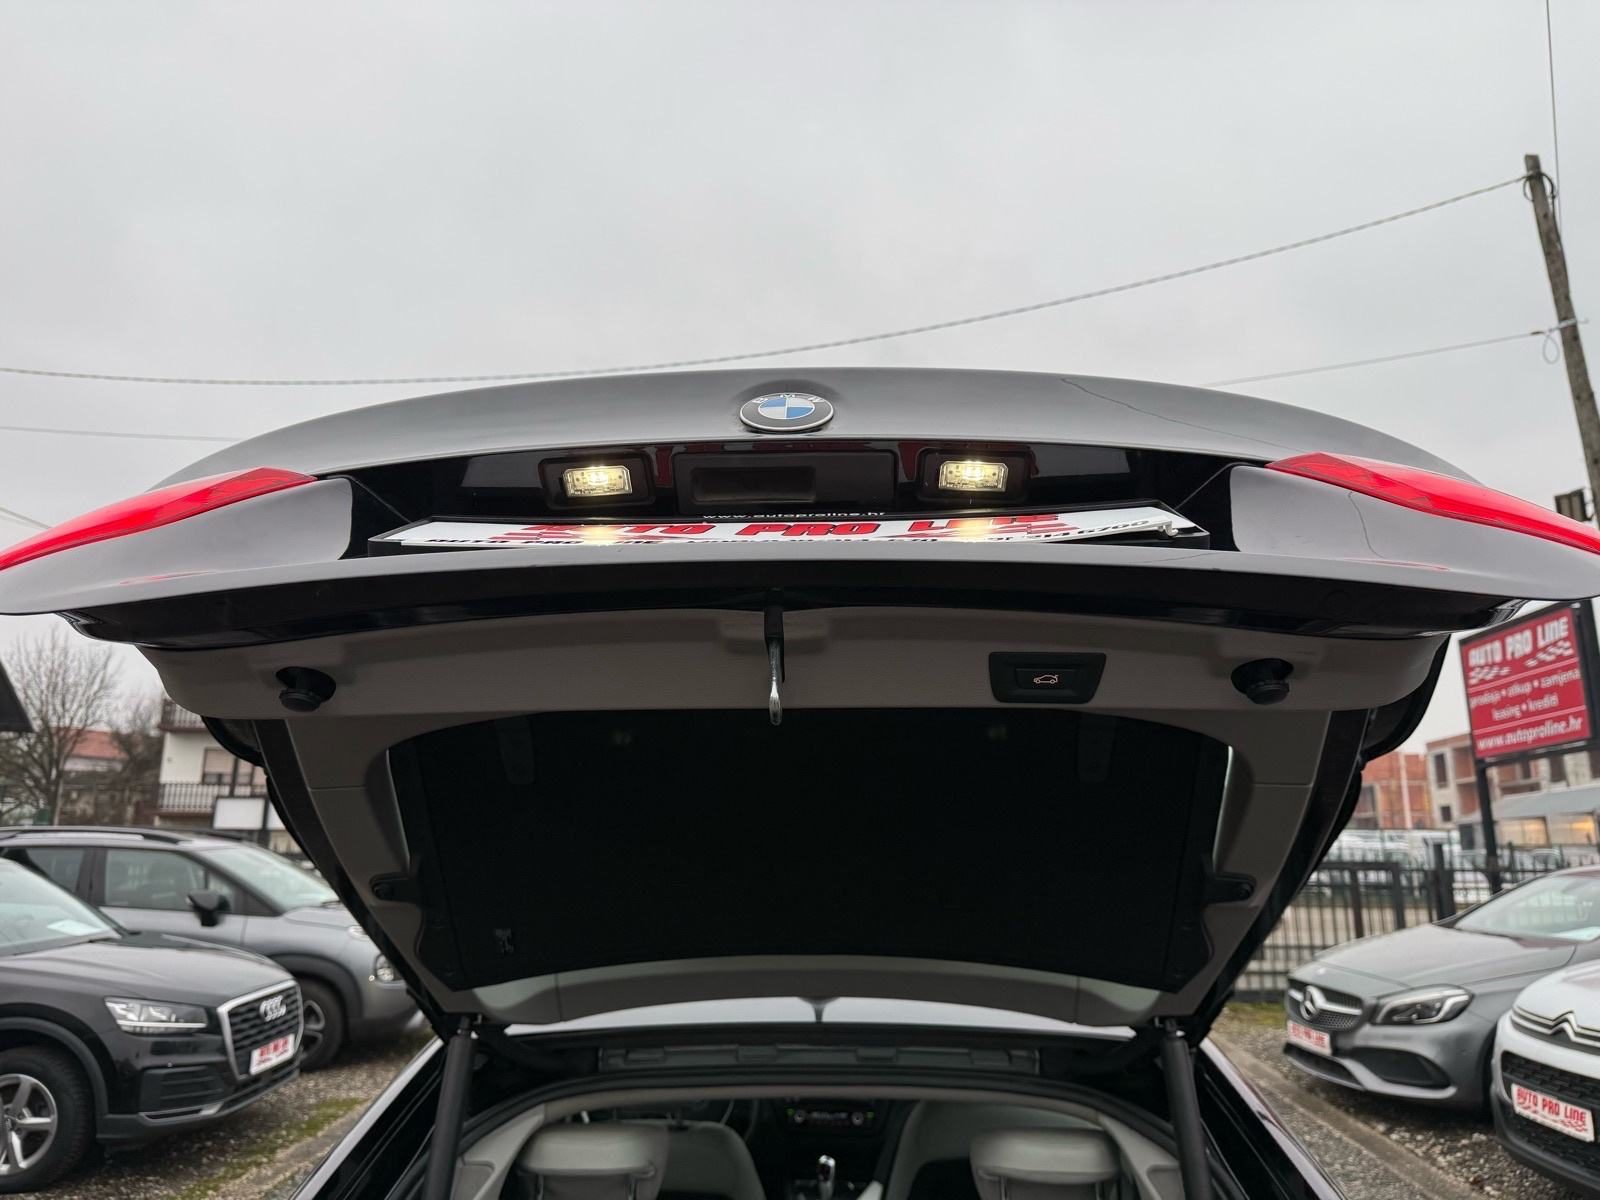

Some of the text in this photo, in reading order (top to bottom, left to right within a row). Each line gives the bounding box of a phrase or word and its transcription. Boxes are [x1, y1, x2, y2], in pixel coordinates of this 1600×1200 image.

[735, 523, 881, 536] PRO
[1469, 616, 1568, 666] AUTO PRO LINE
[1478, 716, 1582, 749] www.autoproline.hr
[1517, 1087, 1587, 1121] AUTO PRO LINE
